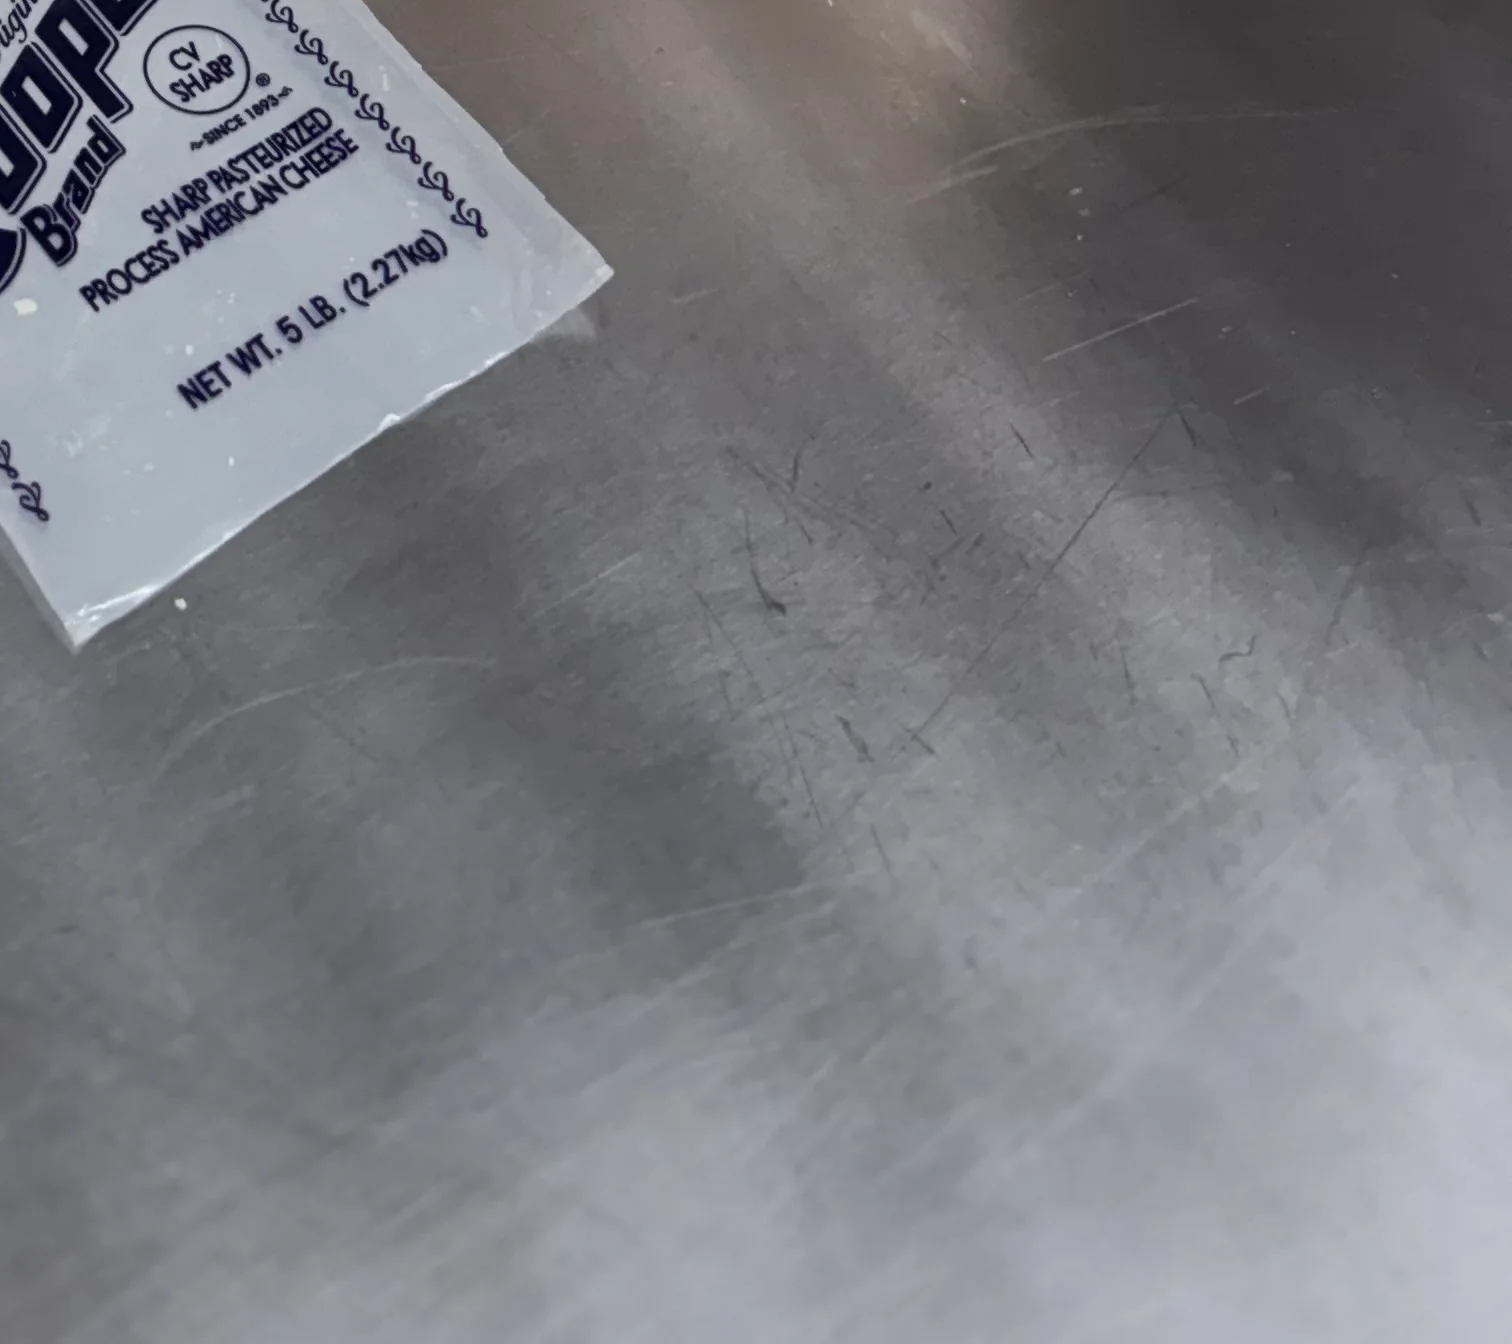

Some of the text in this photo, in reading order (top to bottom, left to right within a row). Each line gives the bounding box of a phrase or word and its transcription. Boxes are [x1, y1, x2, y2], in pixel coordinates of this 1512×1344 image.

[168, 41, 201, 71] CV
[169, 53, 236, 103] SHARP
[202, 94, 280, 145] SINCE 1893
[21, 114, 127, 267] Brand
[78, 128, 360, 313] PROCESS AMERICAN CHEESE
[141, 106, 333, 234] SHARP PASTEURIZED
[177, 228, 449, 410] NET WT. 5 LB. (2.27kg)
